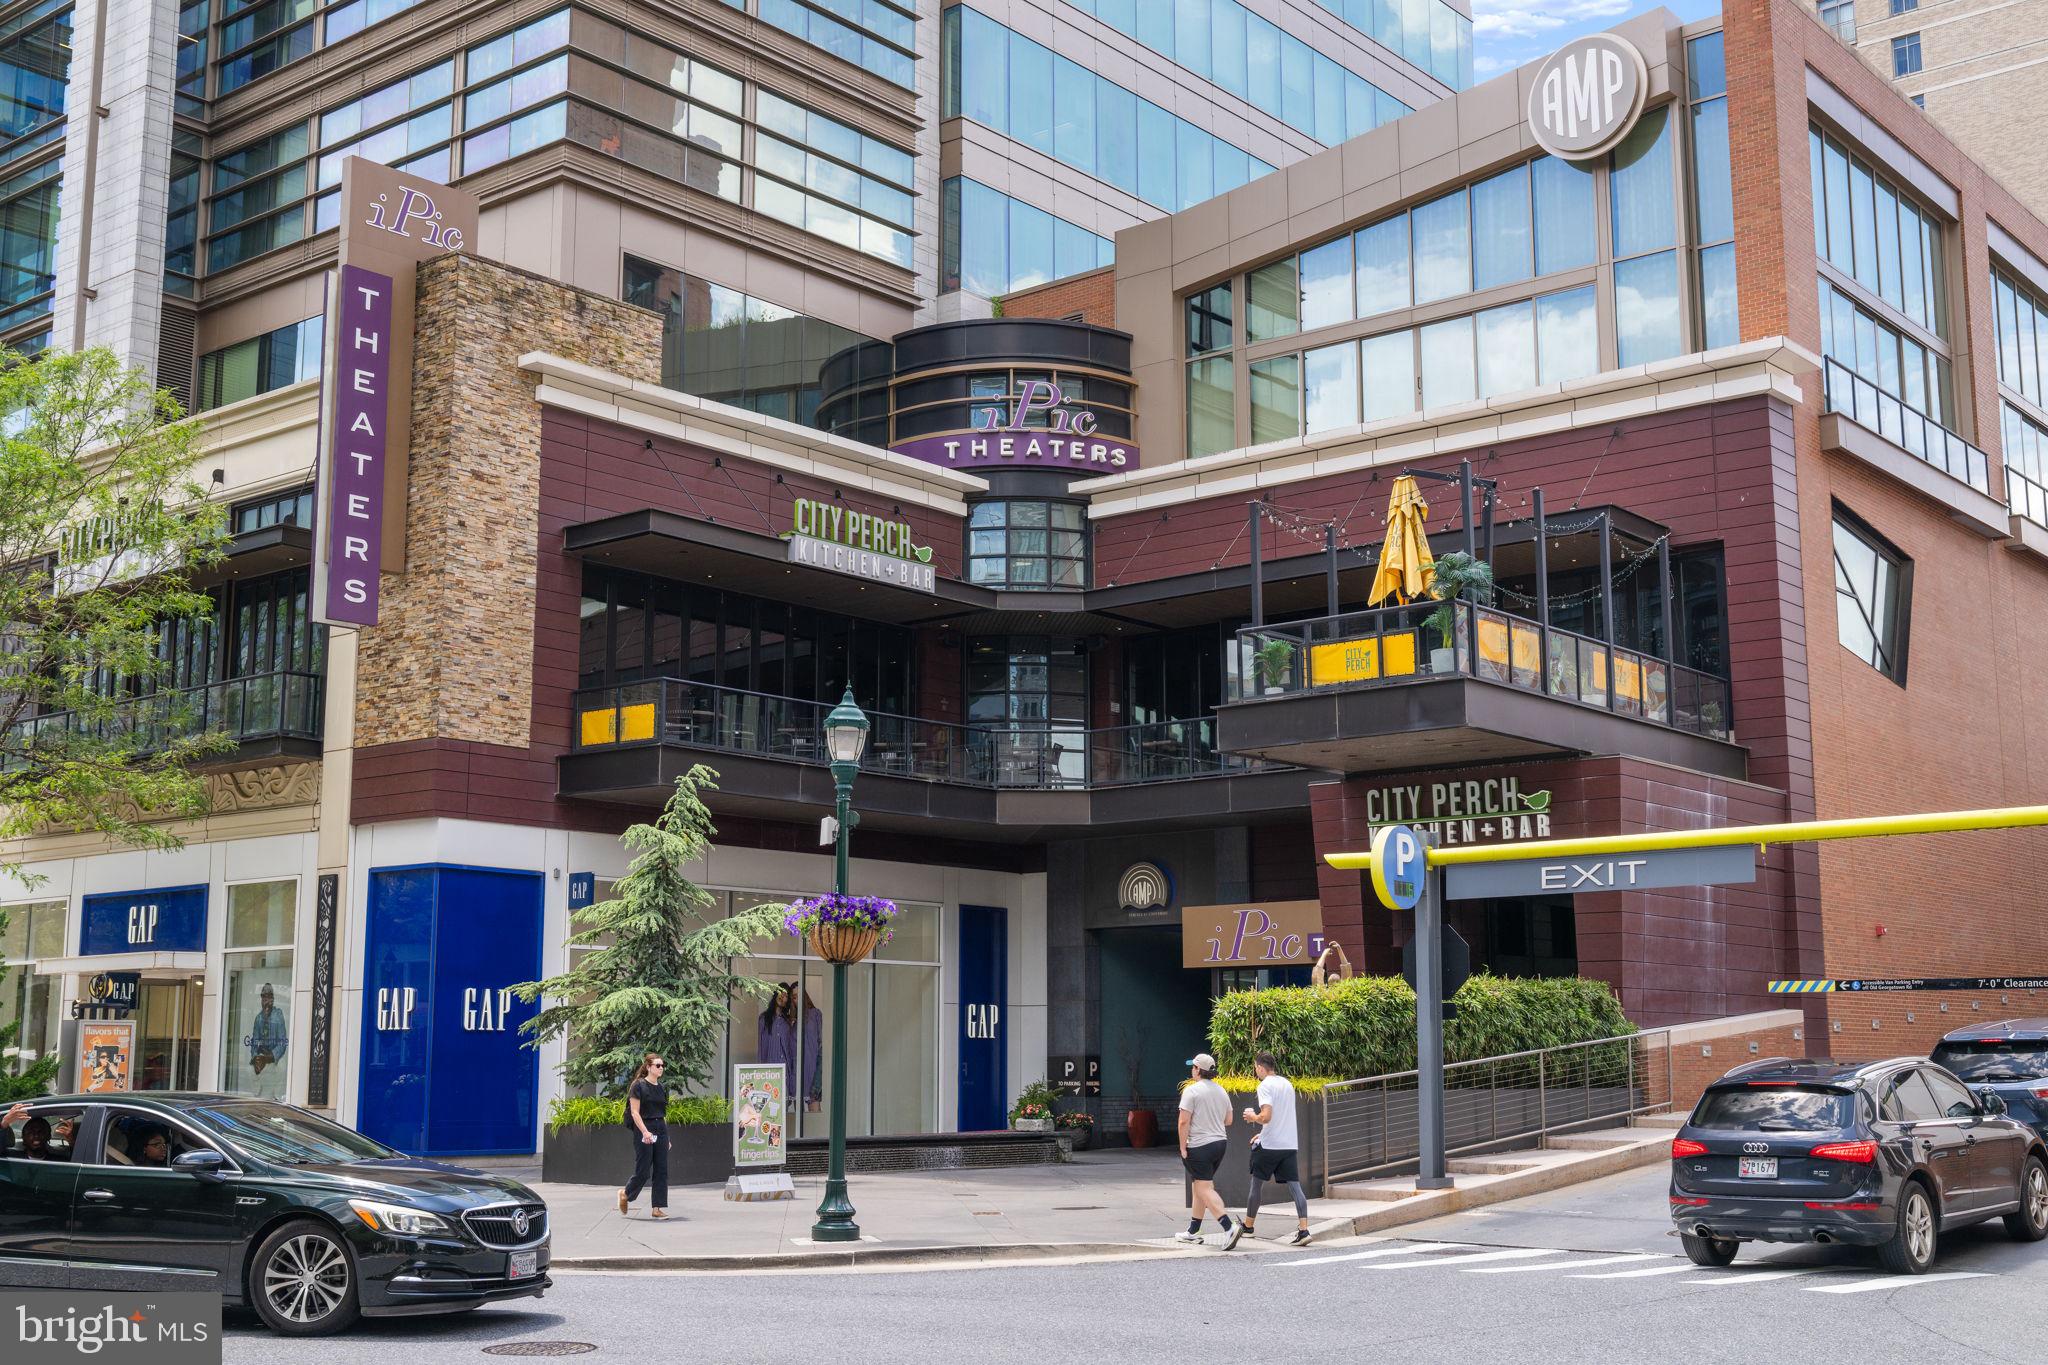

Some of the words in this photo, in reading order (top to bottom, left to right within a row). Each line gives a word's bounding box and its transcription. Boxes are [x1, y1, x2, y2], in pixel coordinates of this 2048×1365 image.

[1542, 48, 1623, 138] AMP
[365, 185, 464, 252] iPic
[977, 379, 1098, 437] iPic
[343, 286, 381, 604] THEATERS
[943, 438, 1127, 468] THEATERS
[794, 498, 843, 542] CITY
[845, 509, 912, 559] PERCH
[799, 539, 881, 579] KITCHEN
[900, 563, 933, 591] BAR
[1345, 648, 1362, 660] CITY
[1345, 657, 1371, 672] PERCH
[1366, 785, 1422, 822] CITY
[1431, 776, 1519, 818] PERCH
[1501, 813, 1551, 840] BAR
[1396, 832, 1415, 876] P
[1541, 860, 1647, 889] EXIT
[571, 881, 588, 900] GAP
[1132, 881, 1152, 905] AMP
[128, 904, 158, 944] GAP
[1203, 909, 1303, 962] iPic
[112, 981, 135, 1000] GAP
[2003, 978, 2048, 988] Clearance
[377, 987, 416, 1031] GAP
[463, 987, 512, 1031] GAP
[967, 1004, 999, 1039] GAP
[85, 1027, 112, 1036] flavors
[113, 1027, 129, 1036] that
[740, 1070, 781, 1083] perfection
[1064, 1061, 1075, 1077] P
[1089, 1061, 1098, 1077] P
[741, 1148, 780, 1161] fingertips
